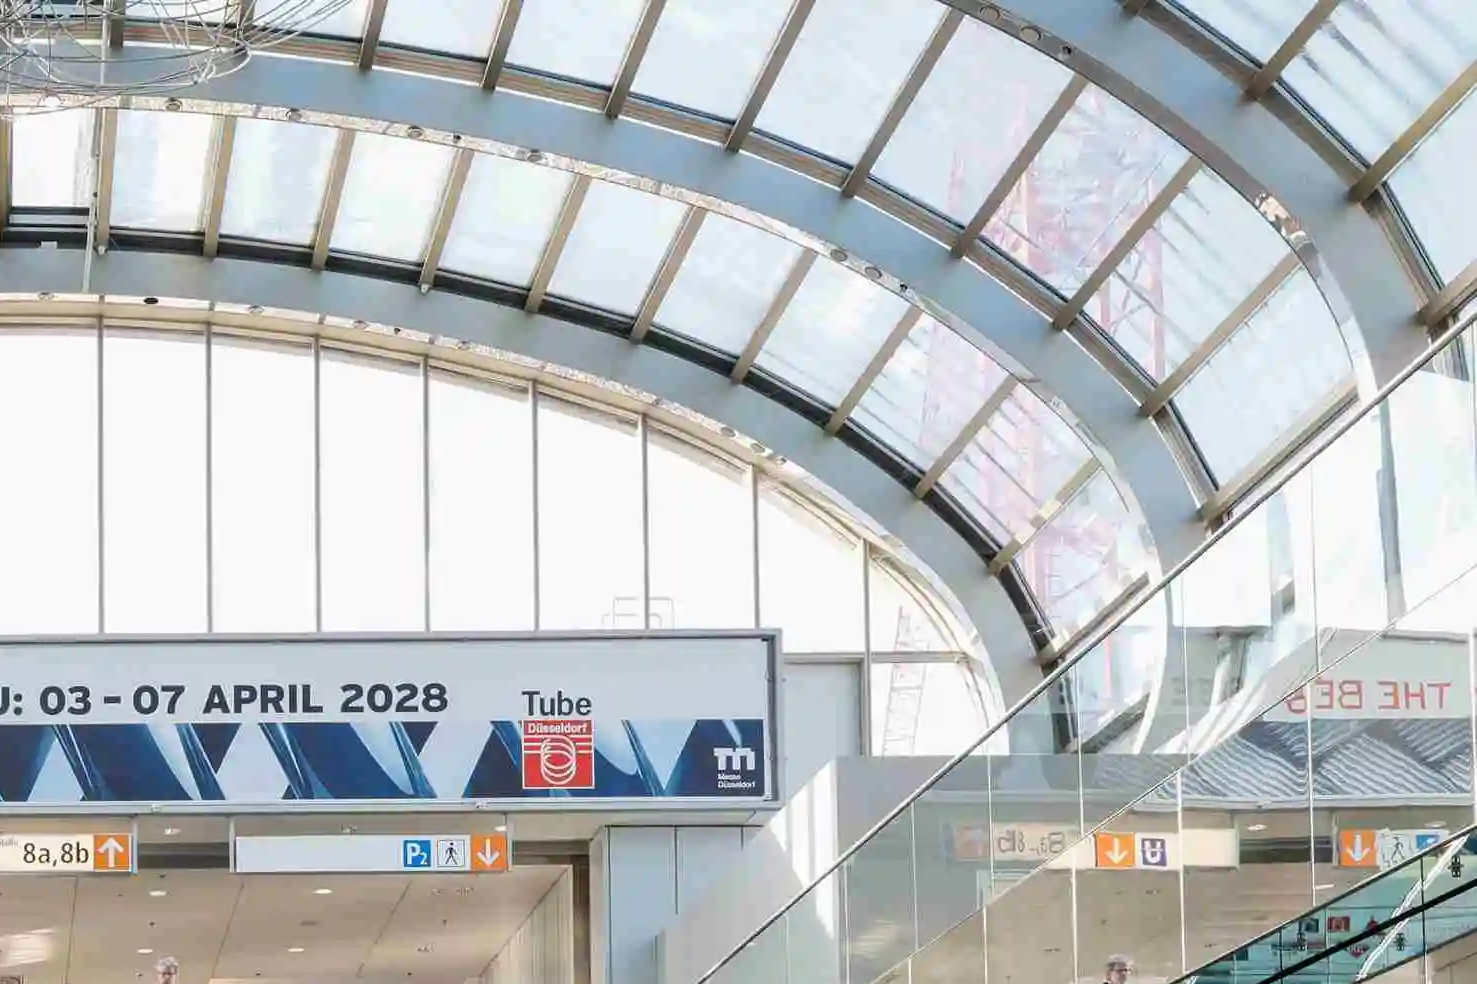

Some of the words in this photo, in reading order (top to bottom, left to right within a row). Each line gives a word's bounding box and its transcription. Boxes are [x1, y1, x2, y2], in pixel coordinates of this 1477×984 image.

[39, 685, 92, 716] 03
[132, 684, 186, 715] 07
[202, 684, 324, 714] APRIL
[340, 683, 448, 713] 2028
[522, 690, 591, 716] Tube
[528, 721, 588, 734] Düsseldorf
[23, 842, 90, 867] 8a,8b
